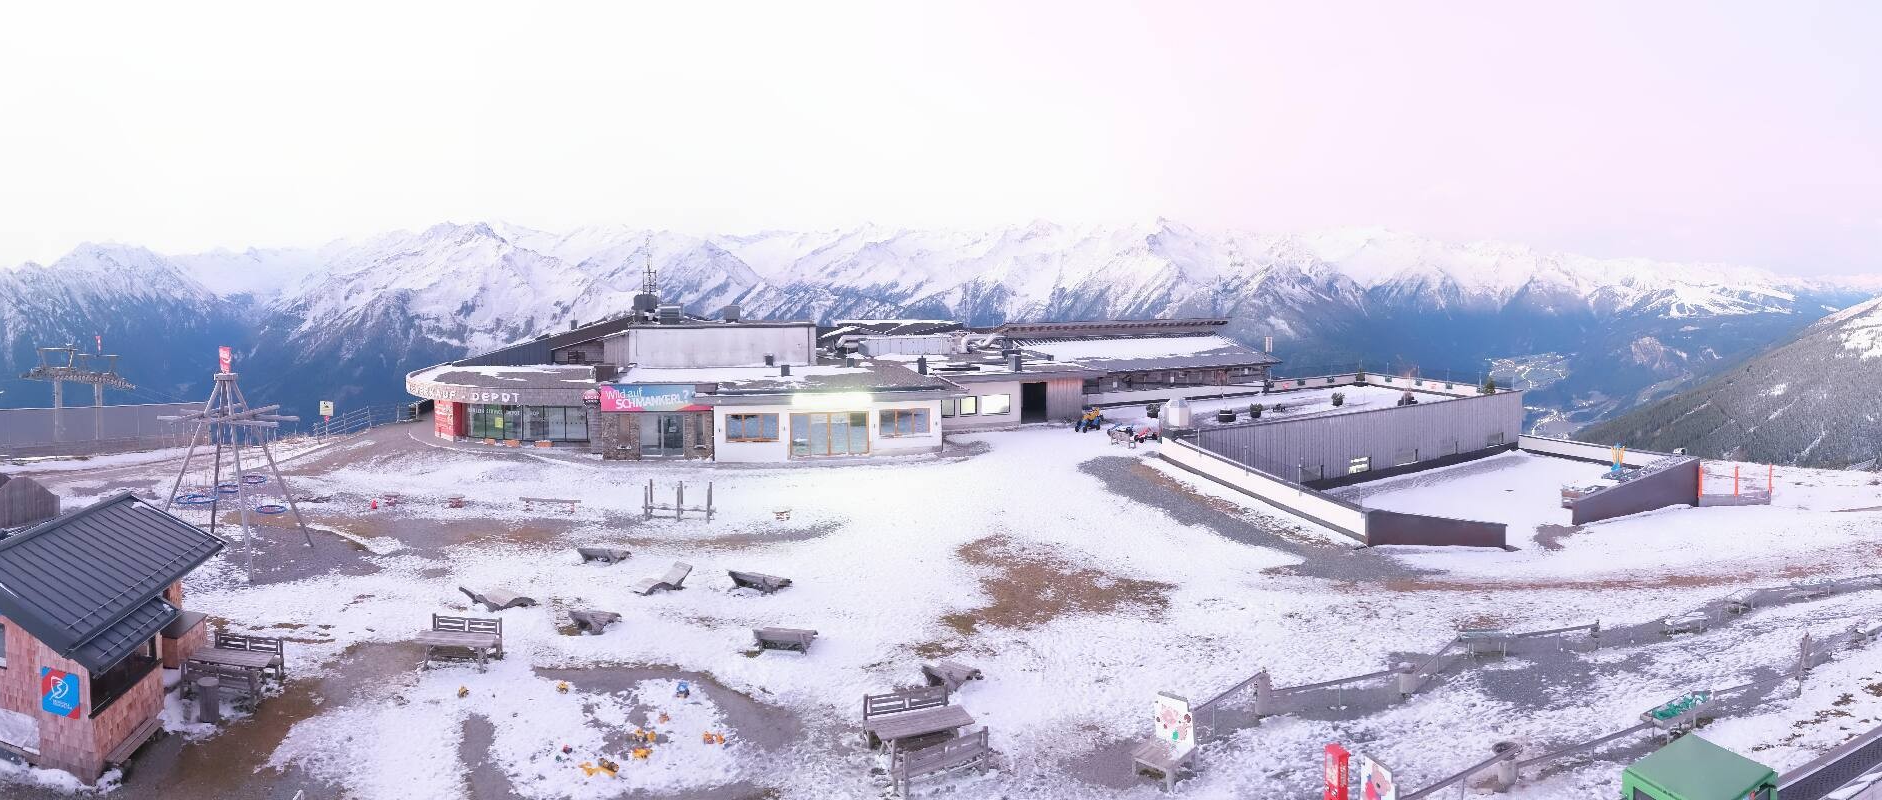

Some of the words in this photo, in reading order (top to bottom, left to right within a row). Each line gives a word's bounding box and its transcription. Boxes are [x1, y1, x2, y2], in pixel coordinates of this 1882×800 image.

[472, 392, 520, 403] DEPOT
[605, 389, 626, 400] Wild
[627, 386, 643, 398] auf
